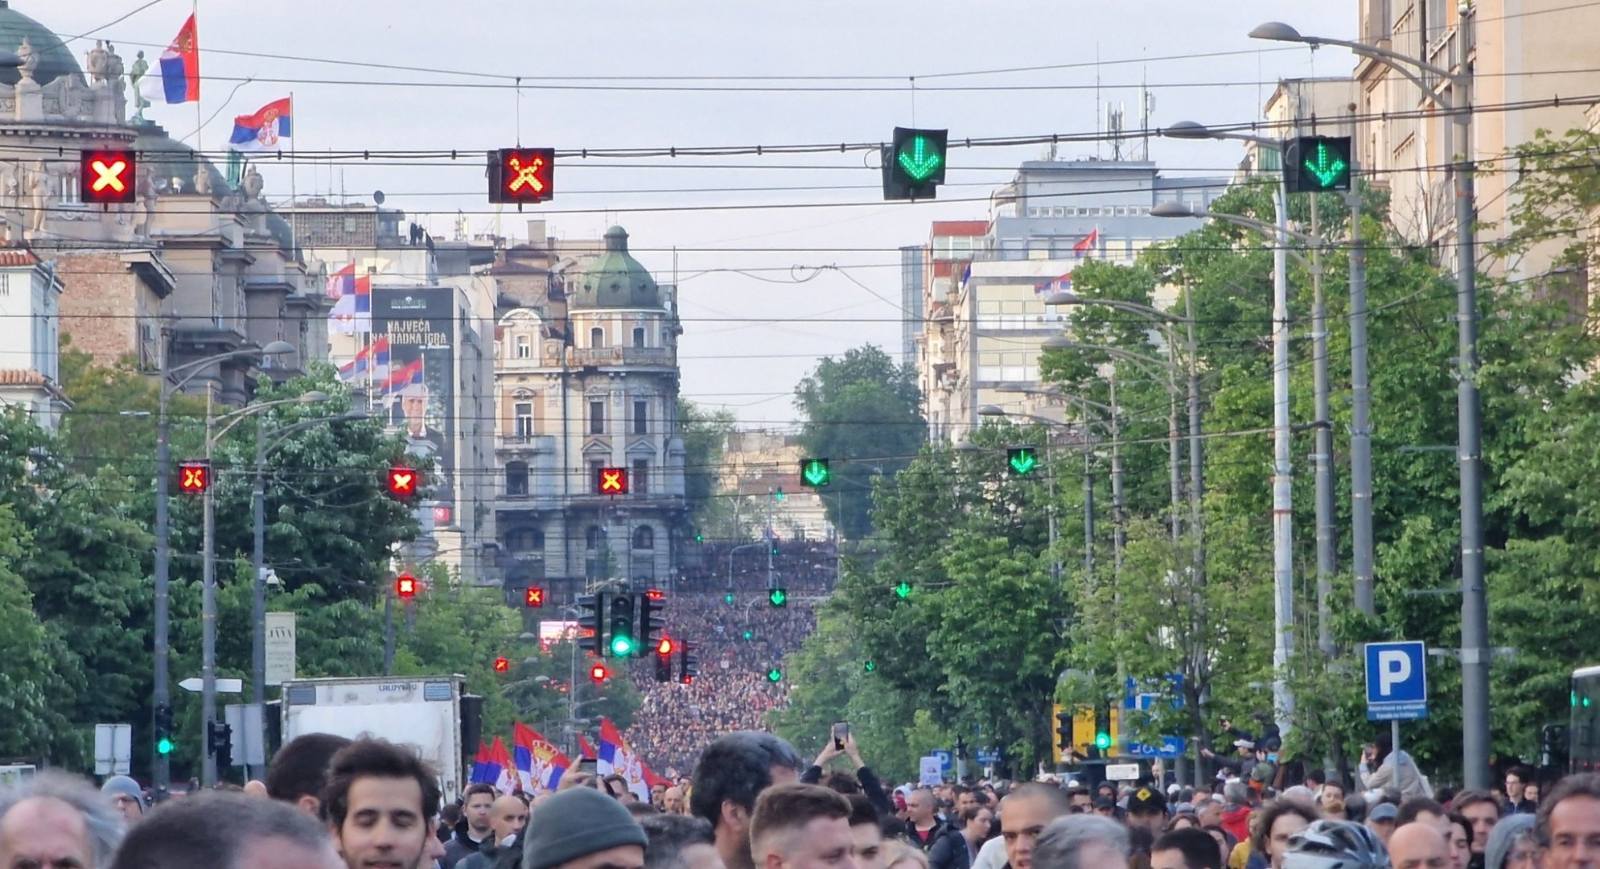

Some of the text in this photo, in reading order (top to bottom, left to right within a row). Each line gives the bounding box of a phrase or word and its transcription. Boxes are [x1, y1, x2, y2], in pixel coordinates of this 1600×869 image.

[387, 319, 430, 332] NAJVEĆA
[372, 333, 447, 345] NARADNA IGRA
[1379, 650, 1411, 696] P
